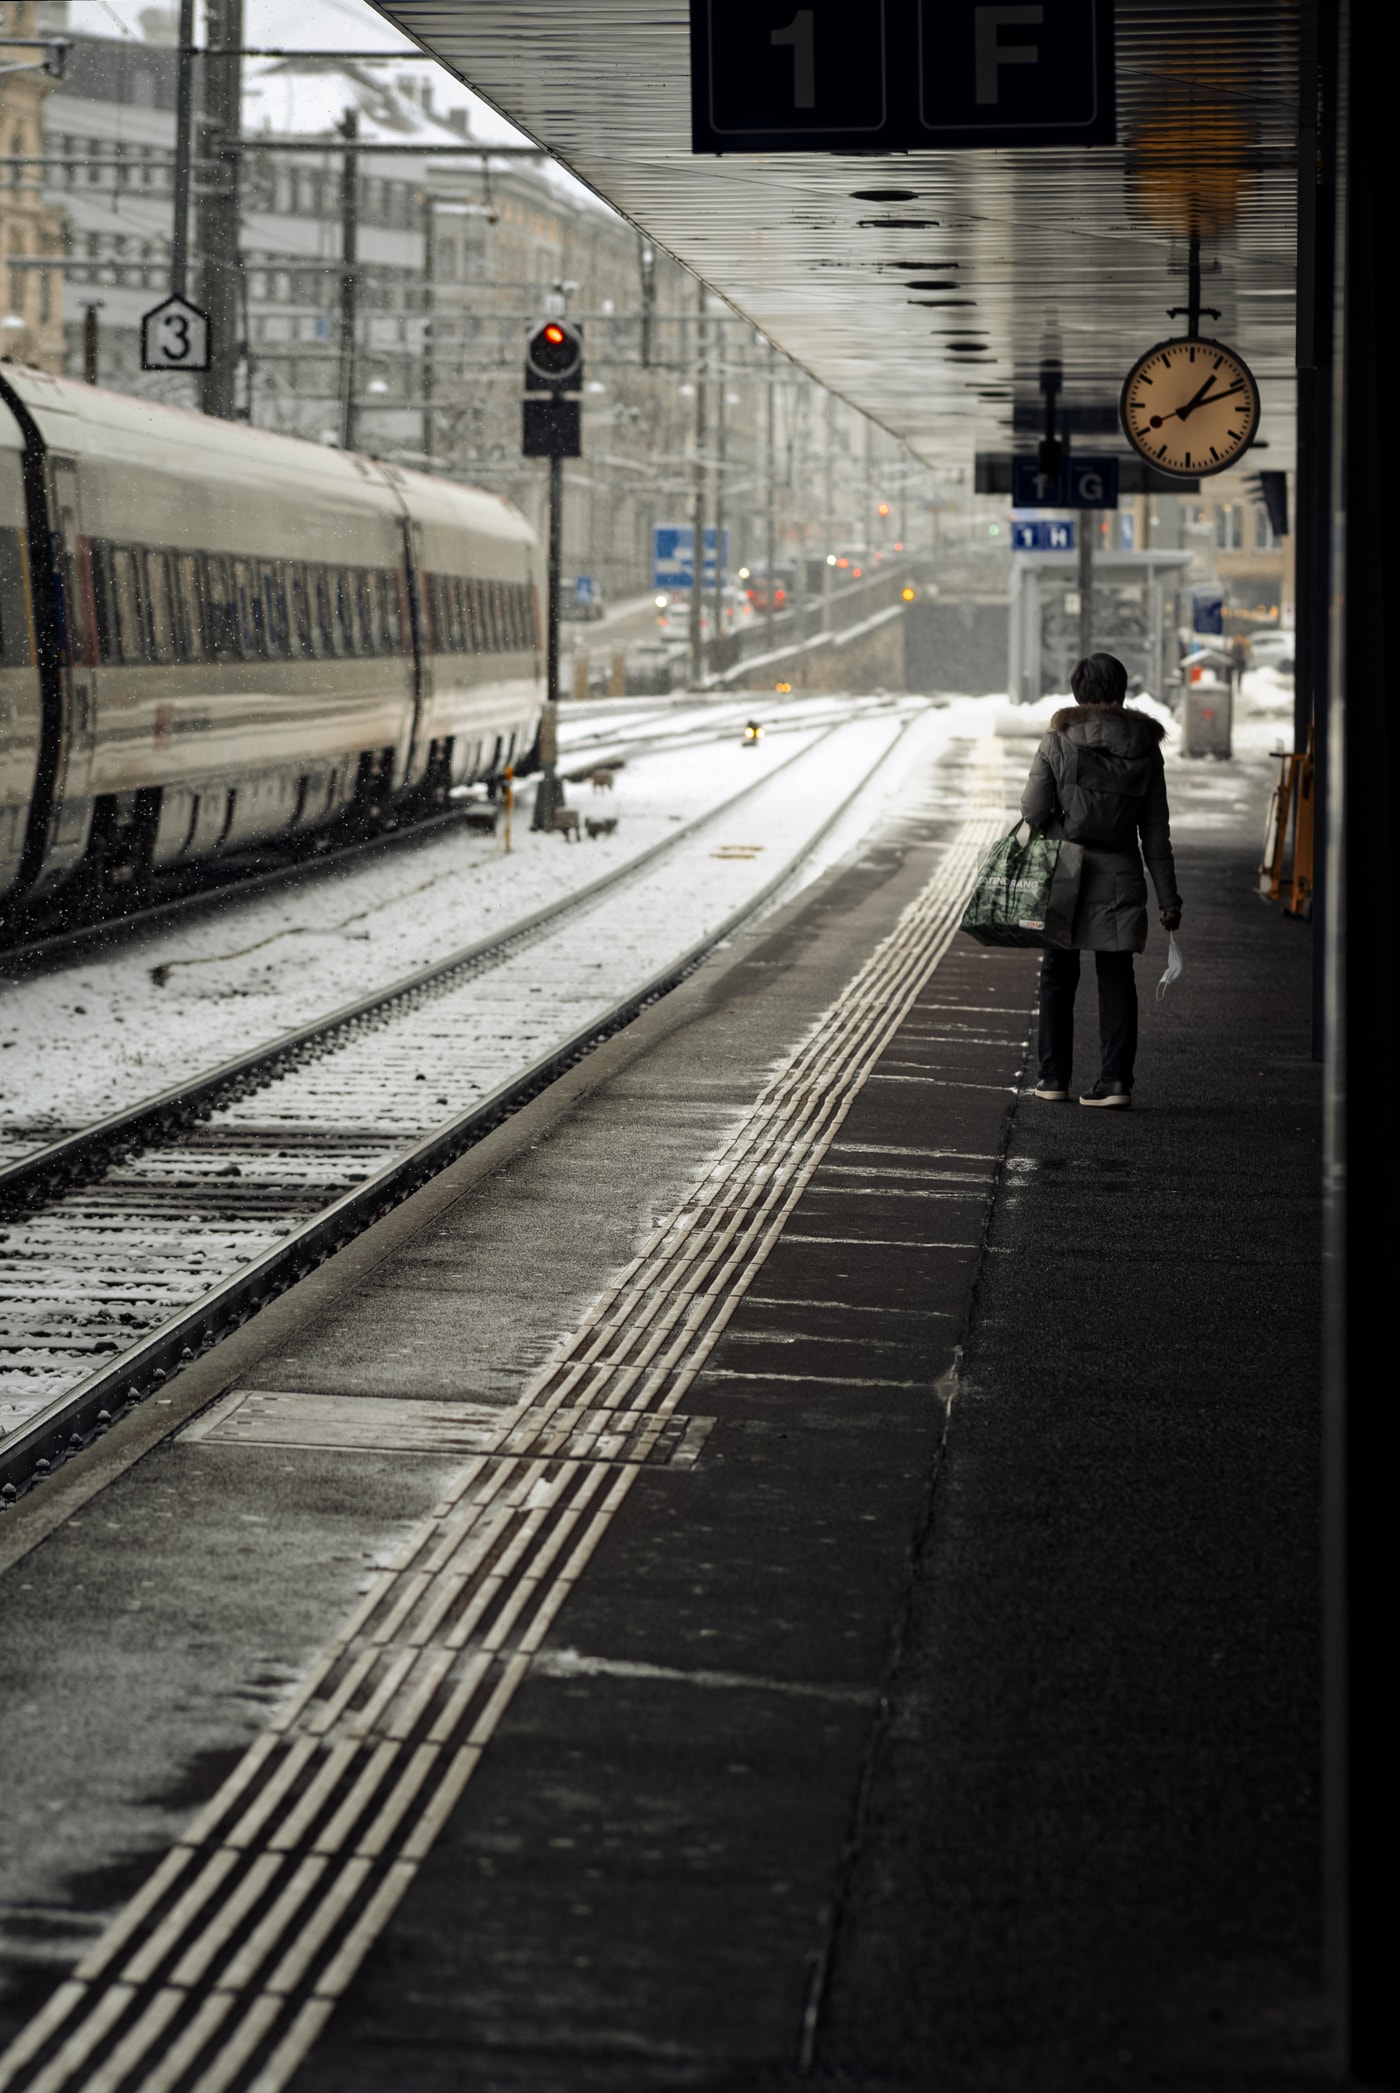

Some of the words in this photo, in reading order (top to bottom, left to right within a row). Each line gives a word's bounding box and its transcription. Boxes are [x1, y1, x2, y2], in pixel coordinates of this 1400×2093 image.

[770, 9, 815, 108] 1
[974, 5, 1044, 104] F
[163, 315, 190, 359] 3
[1032, 473, 1048, 499] 1
[1079, 473, 1103, 499] G
[1021, 527, 1033, 547] 1
[1050, 527, 1067, 547] H
